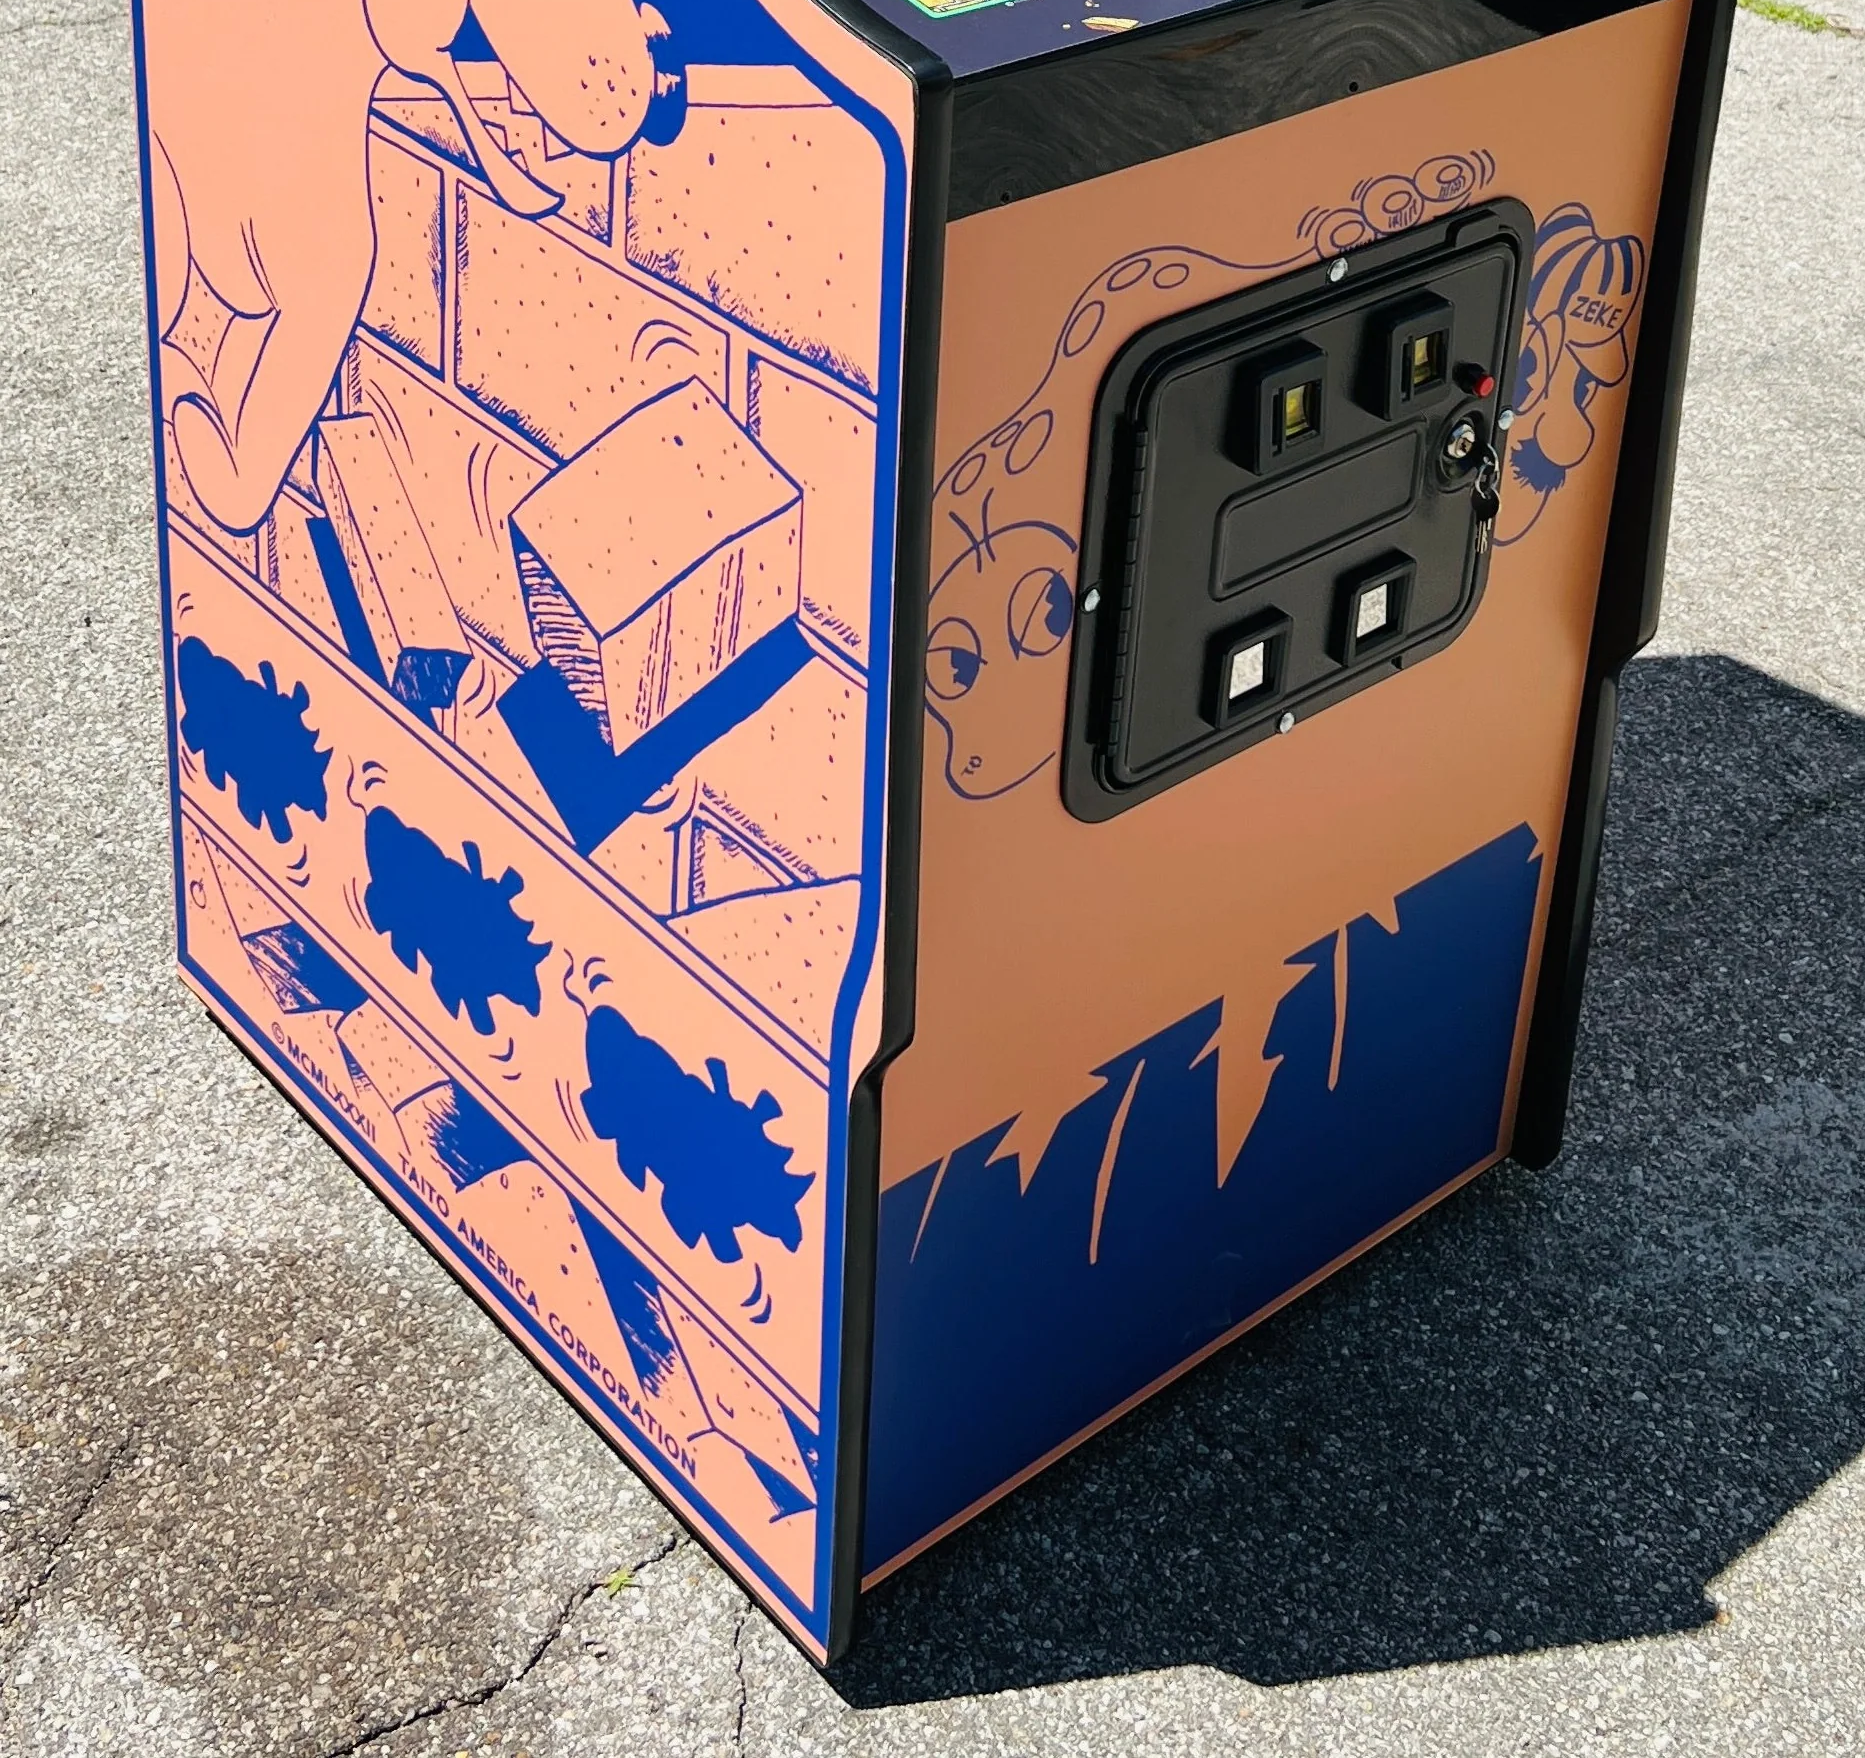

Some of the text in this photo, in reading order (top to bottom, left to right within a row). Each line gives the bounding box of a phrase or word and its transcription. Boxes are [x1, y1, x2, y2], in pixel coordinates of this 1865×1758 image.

[1569, 295, 1623, 329] ZEKE
[398, 1151, 450, 1217] TAITO
[457, 1217, 540, 1316] AMERICA
[548, 1312, 696, 1479] CORPORATION
